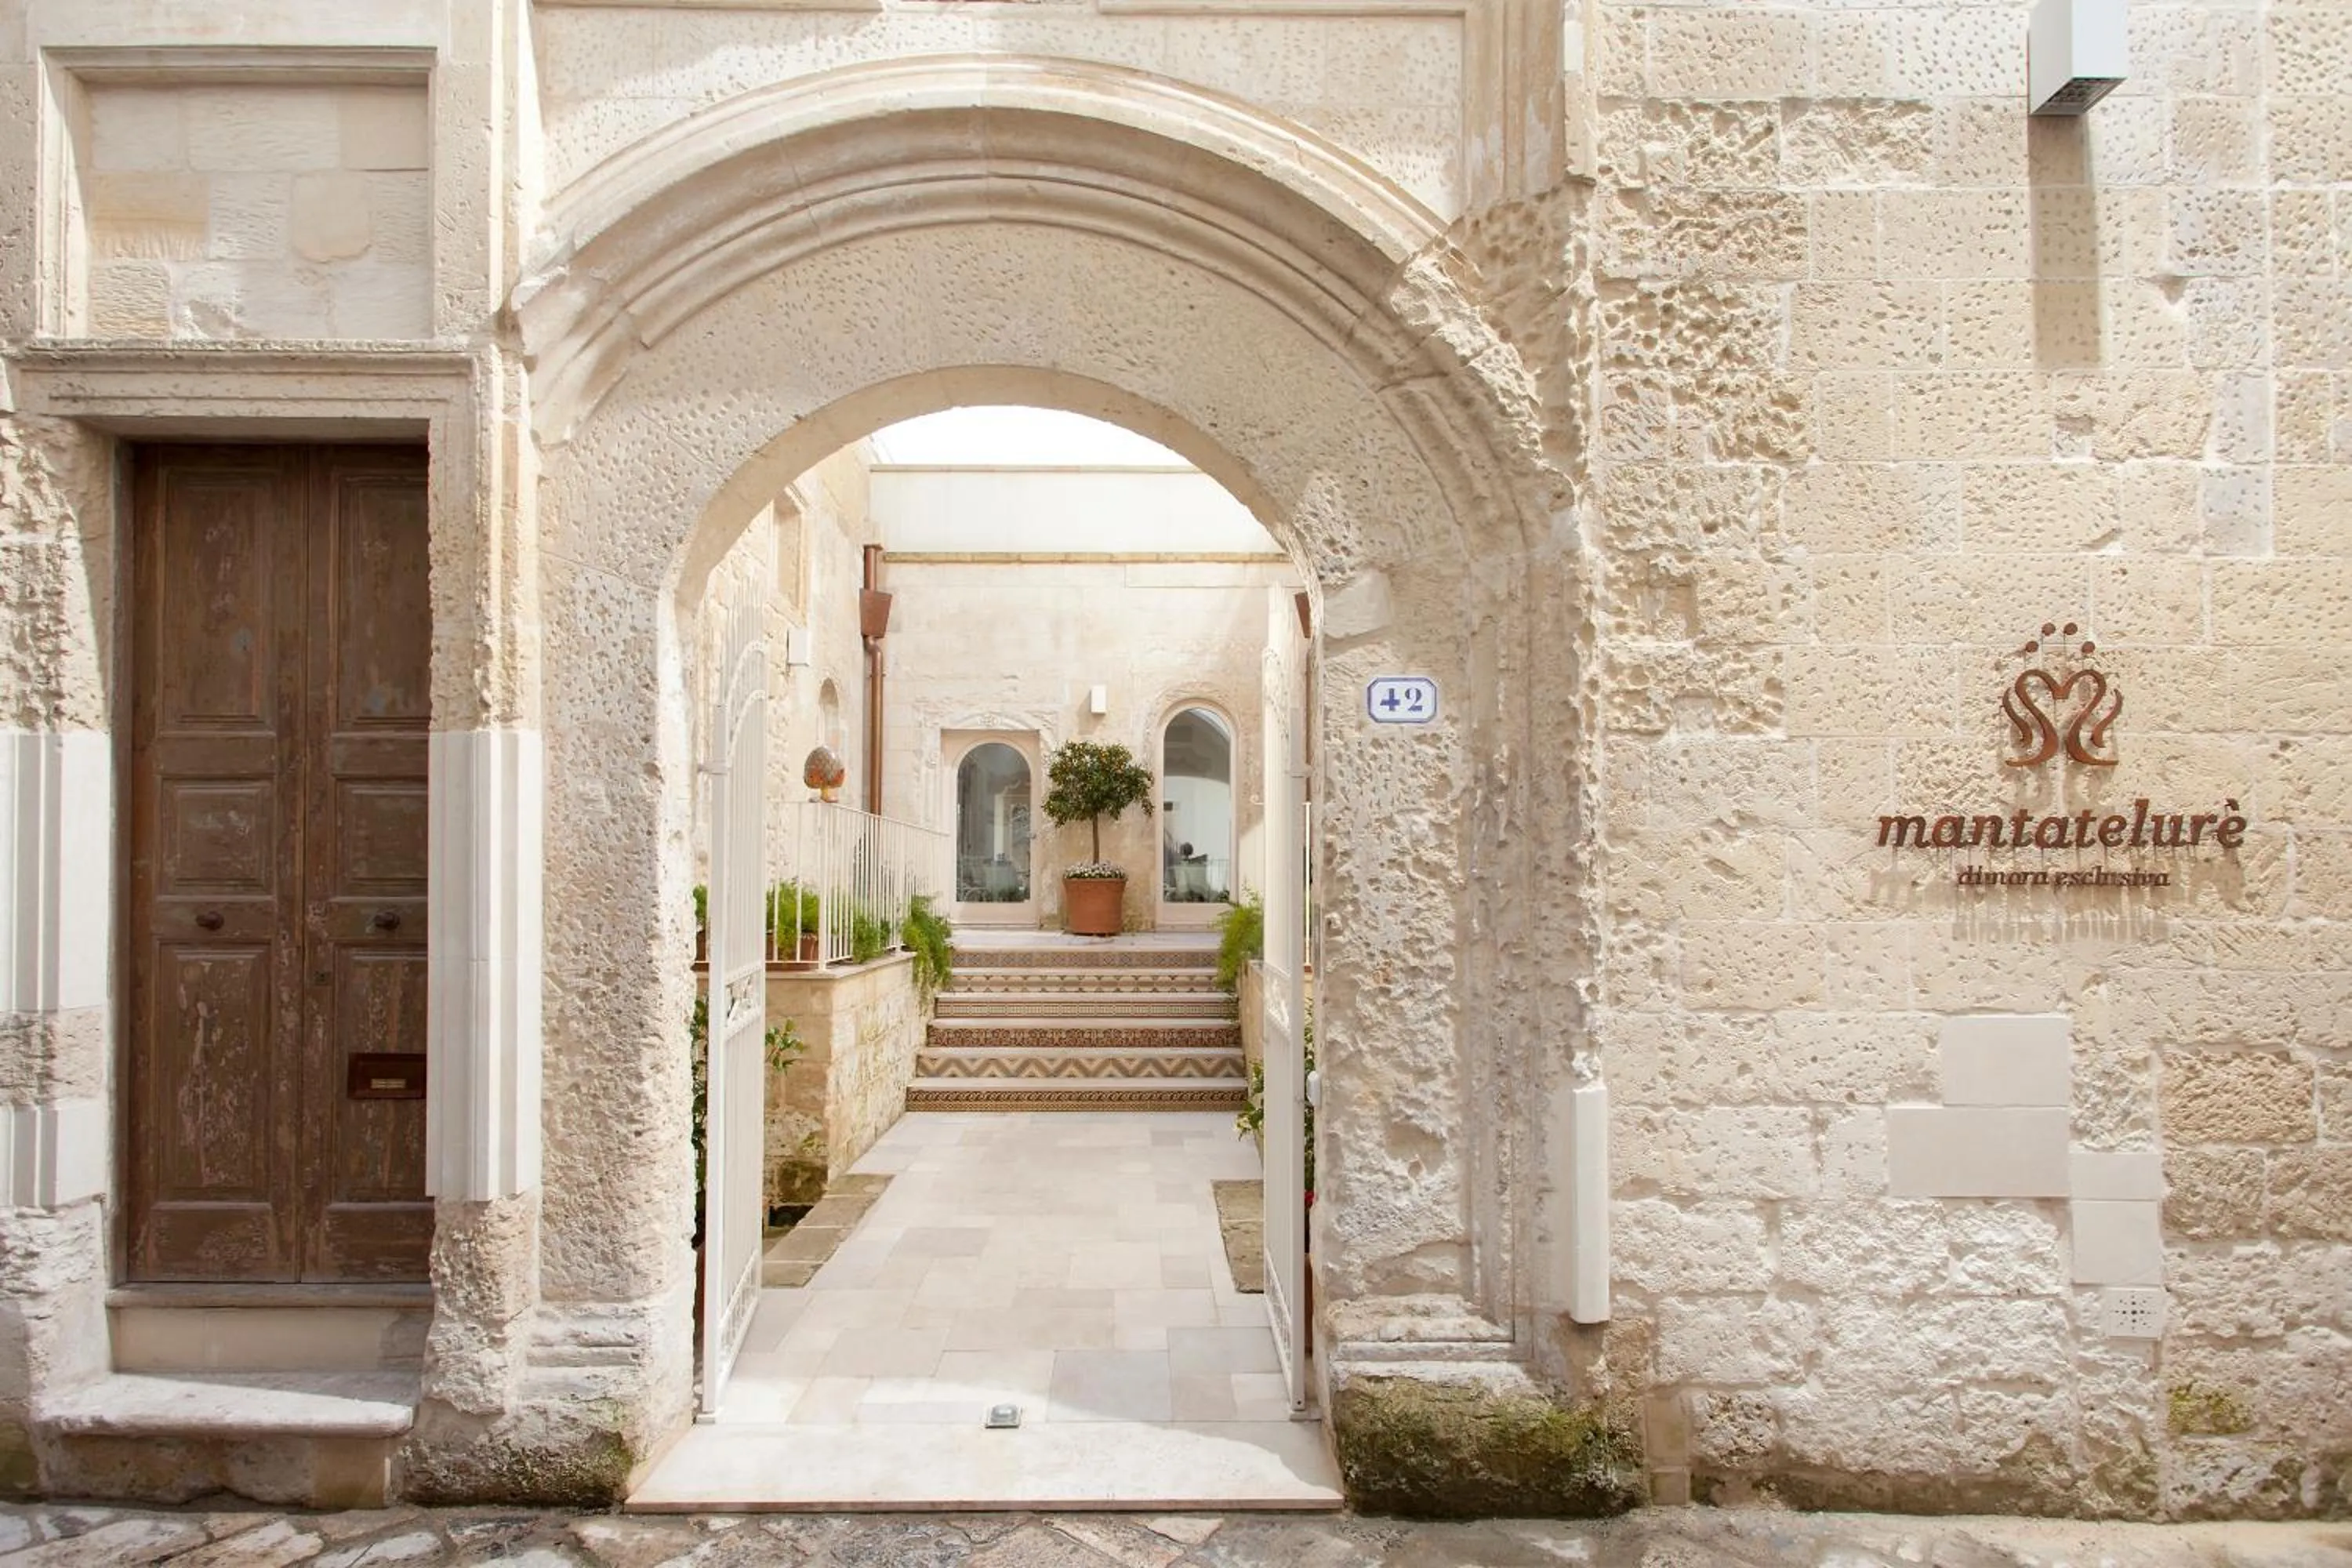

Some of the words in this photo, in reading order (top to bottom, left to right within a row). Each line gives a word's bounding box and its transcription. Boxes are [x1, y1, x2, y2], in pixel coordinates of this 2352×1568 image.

[1380, 688, 1423, 712] 42
[1877, 798, 2247, 849] mantatelurè
[1958, 865, 2049, 886] dimora
[2055, 866, 2170, 887] esclusiva
